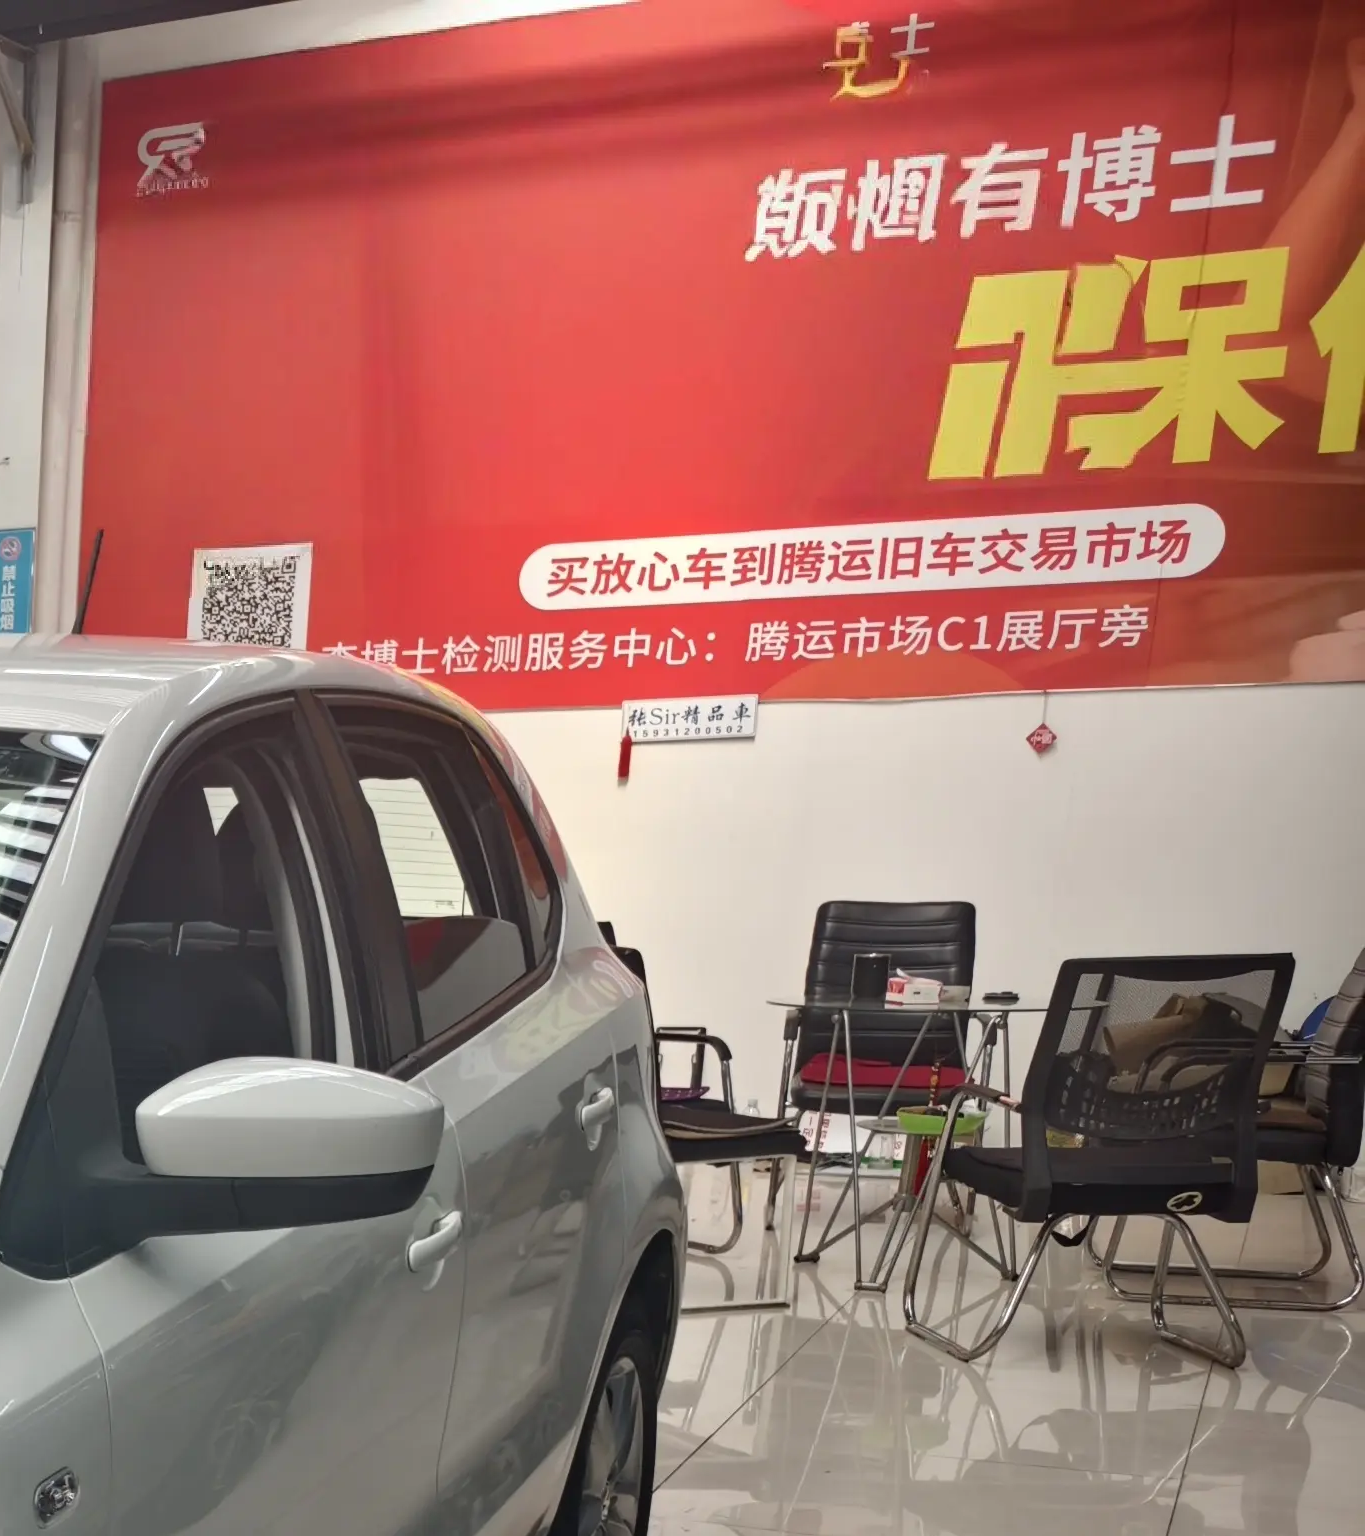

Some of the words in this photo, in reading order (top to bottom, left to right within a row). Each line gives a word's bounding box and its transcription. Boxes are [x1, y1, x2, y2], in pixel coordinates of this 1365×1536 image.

[546, 518, 1194, 598] 买放心车到腾运旧车交易市场
